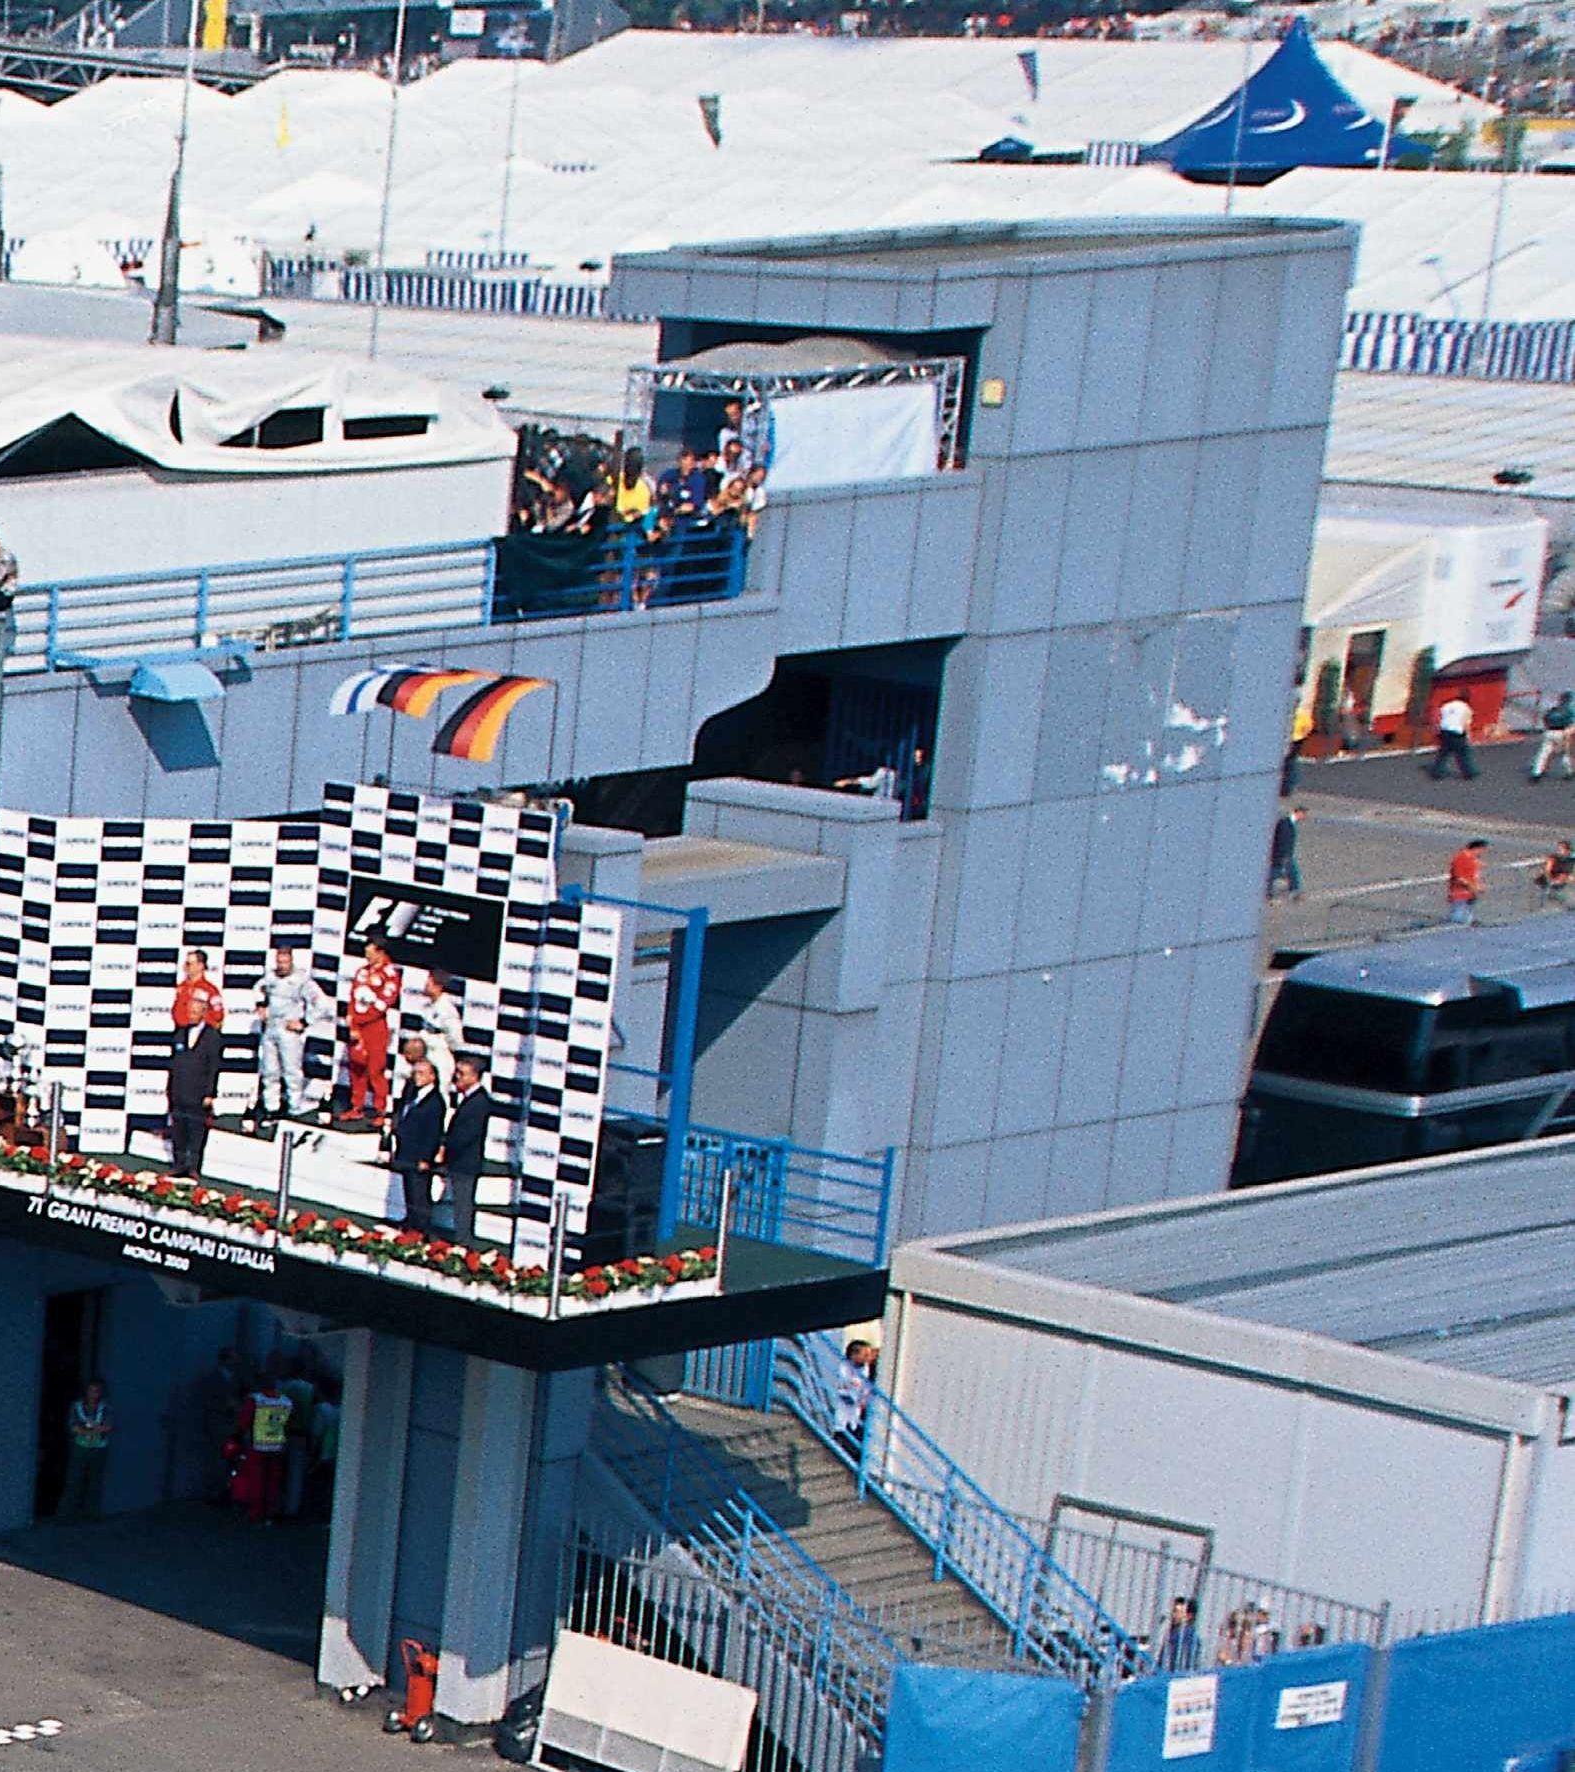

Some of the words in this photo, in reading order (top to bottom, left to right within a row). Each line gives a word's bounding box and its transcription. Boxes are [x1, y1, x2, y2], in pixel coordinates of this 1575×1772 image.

[47, 1201, 92, 1227] GRAN
[91, 1212, 147, 1239] PREMIO
[149, 1226, 216, 1258] CAMPARI
[123, 1244, 162, 1264] MONZA
